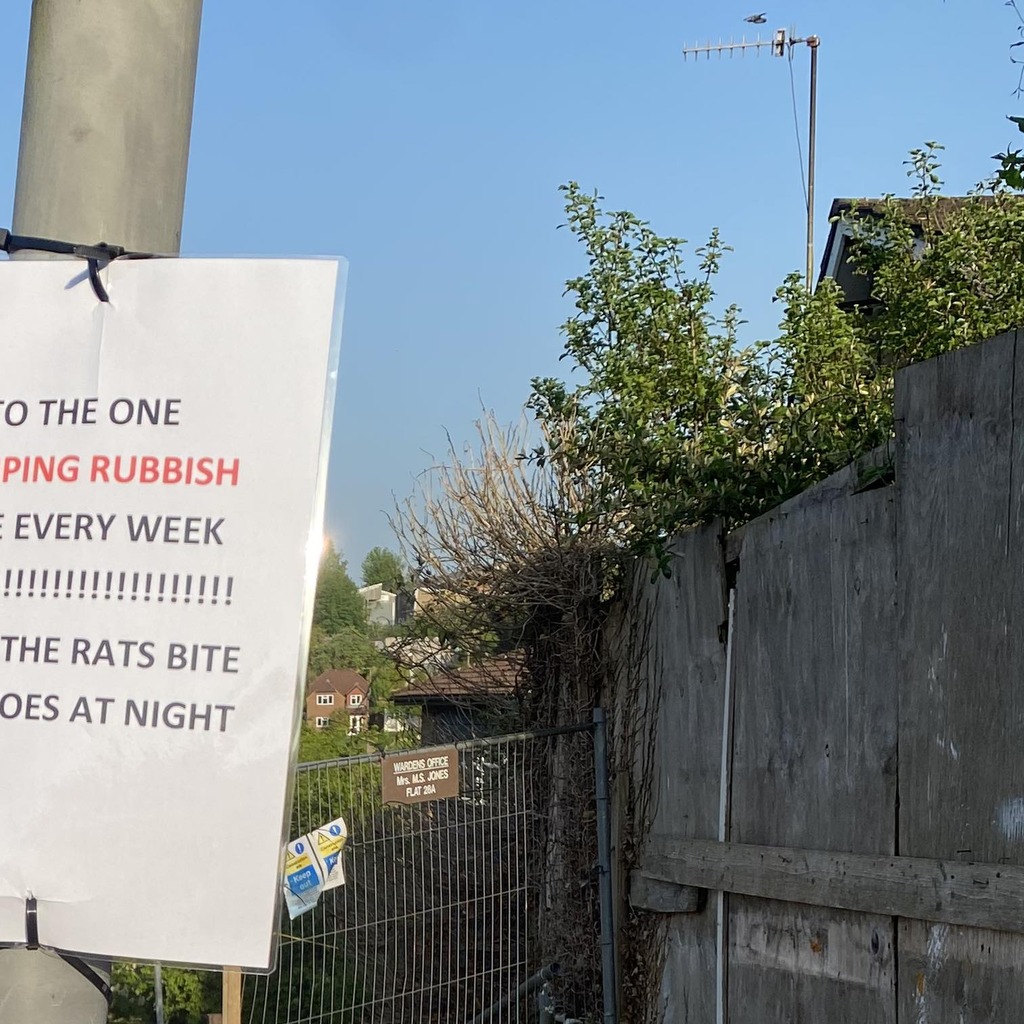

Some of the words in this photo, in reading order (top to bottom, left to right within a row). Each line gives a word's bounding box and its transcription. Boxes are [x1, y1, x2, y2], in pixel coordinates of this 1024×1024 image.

[38, 399, 99, 426] THE
[108, 398, 182, 426] ONE
[90, 455, 240, 486] RUBBISH
[14, 513, 117, 541] EVERY
[126, 514, 225, 546] WEEK
[0, 635, 61, 664] THE
[71, 637, 155, 669] RATS
[167, 643, 241, 674] BITE
[68, 696, 116, 725] AT
[124, 699, 236, 733] NIGHT
[393, 759, 426, 772] WARDENS
[426, 756, 449, 768] OFFICE
[396, 774, 411, 786] Mrs.
[427, 769, 449, 782] JONES
[406, 786, 422, 797] FLAT
[293, 870, 312, 884] Keep
[299, 880, 312, 891] out
